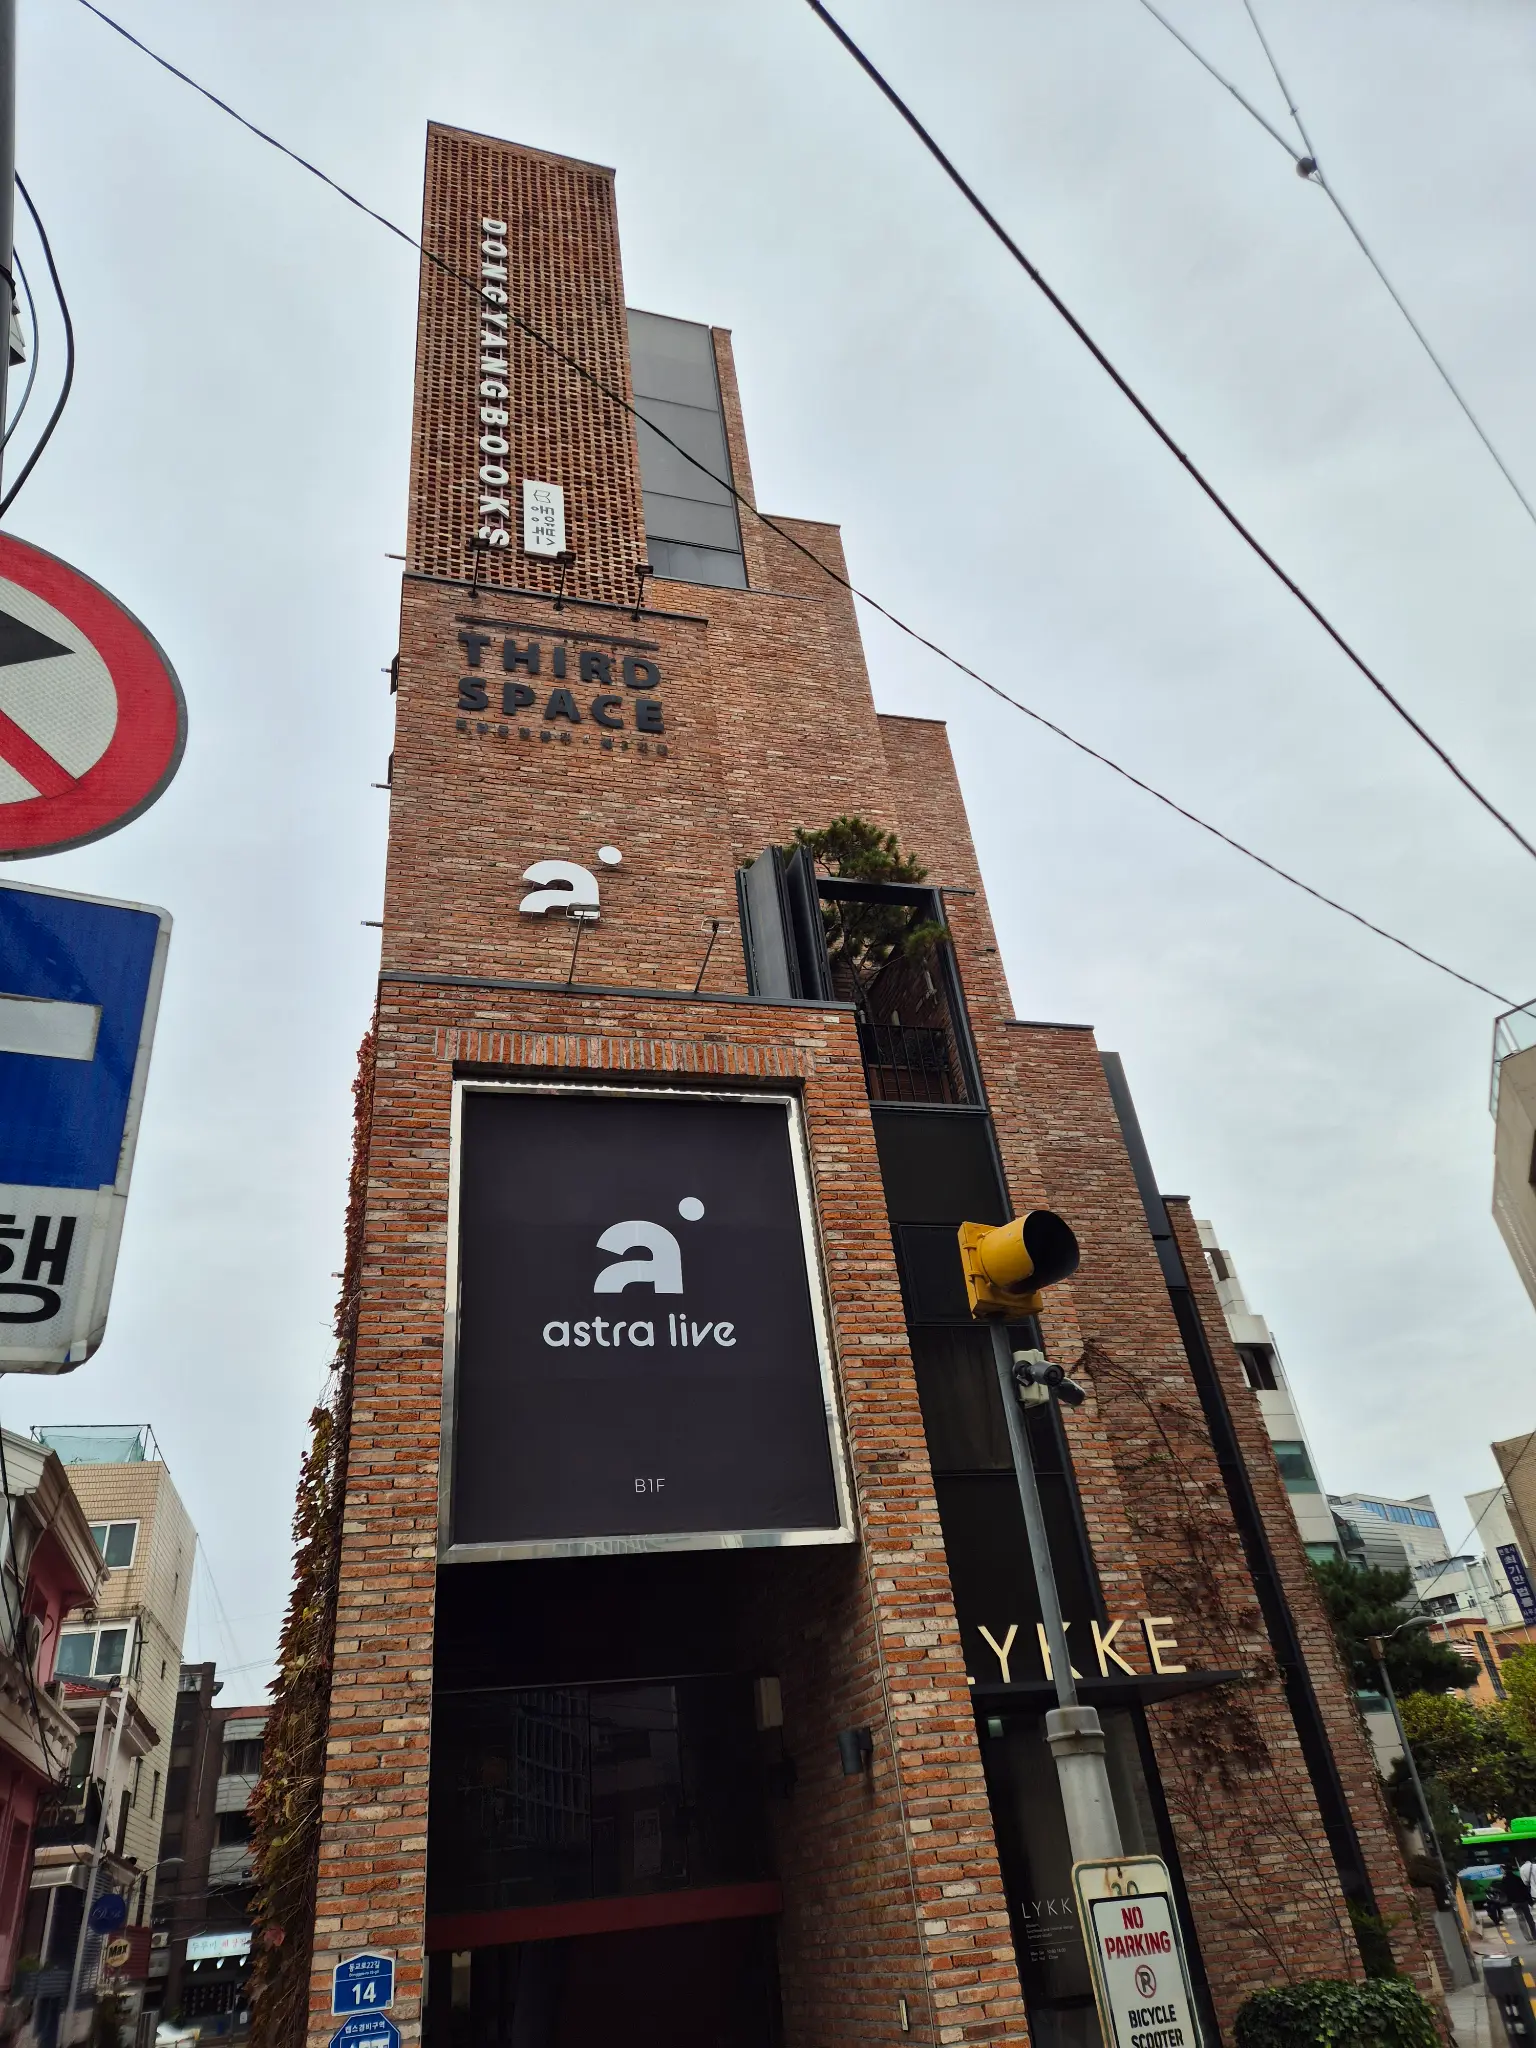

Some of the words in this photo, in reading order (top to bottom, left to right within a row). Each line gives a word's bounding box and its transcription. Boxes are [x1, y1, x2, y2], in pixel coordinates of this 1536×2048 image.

[479, 217, 510, 549] DONGYANGBOOKS
[530, 505, 556, 546] 동양북스
[458, 632, 661, 690] THIRD
[458, 676, 665, 734] SPACE
[543, 1316, 655, 1347] astra
[669, 1313, 737, 1347] live
[634, 1478, 665, 1493] B1F
[967, 1617, 1187, 1685] YKKE
[1021, 1898, 1073, 1918] LYKK
[1120, 1906, 1144, 1930] NO
[1104, 1931, 1172, 1960] PARKING
[348, 1960, 380, 1973] 동교로22길
[352, 1982, 376, 2005] 14
[1128, 2004, 1177, 2028] BICYCLE
[1131, 2028, 1184, 2048] SCOOTER
